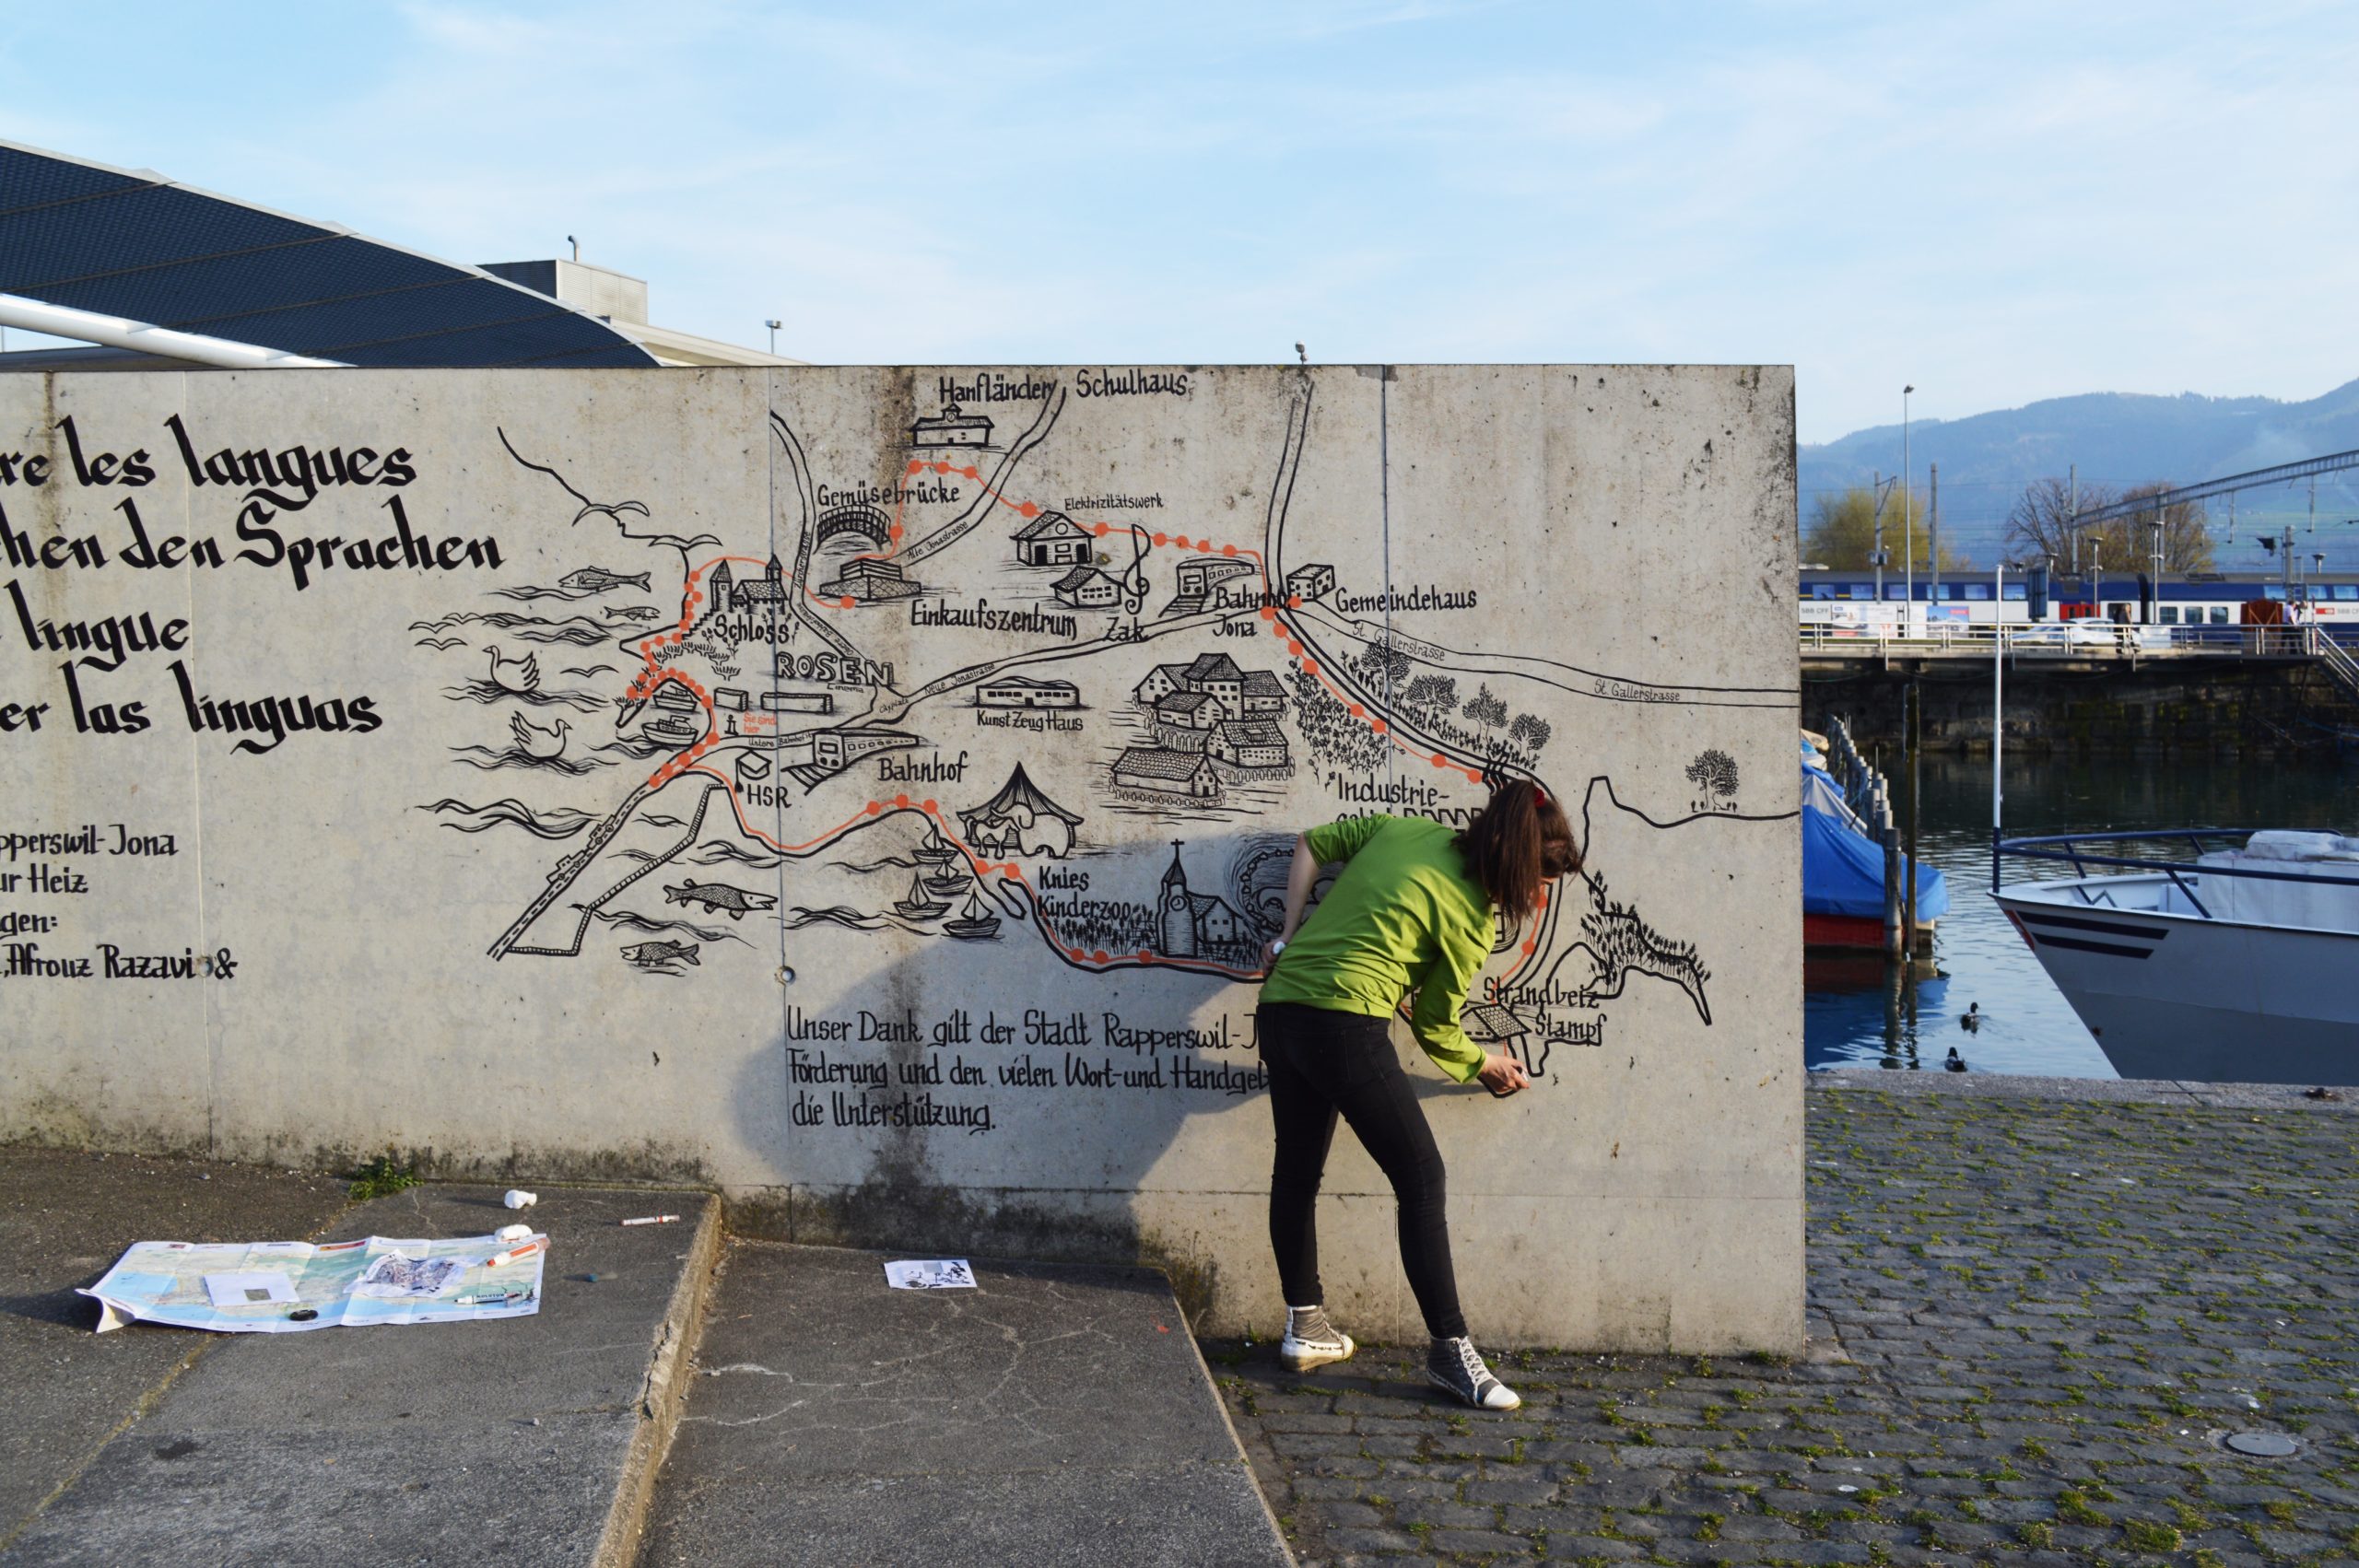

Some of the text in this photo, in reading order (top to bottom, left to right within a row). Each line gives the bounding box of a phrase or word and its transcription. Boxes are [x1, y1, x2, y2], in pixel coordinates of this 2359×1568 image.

[939, 369, 1188, 404] Hanfländer Schulhaus
[0, 413, 417, 511] re les langues
[817, 484, 960, 508] Gemüsebrücke
[1064, 493, 1165, 511] Elektrizitätswerk
[0, 494, 505, 591] hen den Sprachen
[925, 521, 969, 552] Jonastrasse
[1214, 583, 1291, 609] Bahnho
[1334, 584, 1478, 614] Gemeindehaus
[4, 579, 190, 673] lingue
[712, 614, 791, 645] Schloss
[910, 599, 1078, 639] Einkaufszentrum
[1105, 616, 1150, 643] Zak
[1213, 614, 1259, 638] Jona
[1374, 628, 1446, 661] Gallerstrasse
[775, 650, 895, 688] ROSEN
[950, 662, 996, 686] Jonastrasse
[58, 660, 151, 734] las
[166, 659, 383, 755] linguas
[1611, 683, 1681, 702] Gallerstrasse
[877, 751, 968, 784] Bahnhof
[746, 784, 792, 810] HSR
[1337, 772, 1450, 807] Industrie-
[27, 862, 89, 894] Heiz
[1039, 865, 1090, 891] Knies
[1037, 894, 1132, 920] Kinderzoo
[96, 943, 194, 979] Razavi
[787, 1004, 853, 1042] Unser
[856, 1008, 924, 1043] Dank
[927, 1009, 973, 1047] gilt
[980, 1011, 1016, 1046] der
[1024, 1009, 1093, 1047] Stadt
[1534, 1012, 1608, 1047] Stampf
[786, 1047, 888, 1091] Förderung
[898, 1052, 945, 1085] und
[949, 1055, 988, 1086] den
[998, 1054, 1058, 1088] vielen
[792, 1090, 997, 1136] die Unterstützung.
